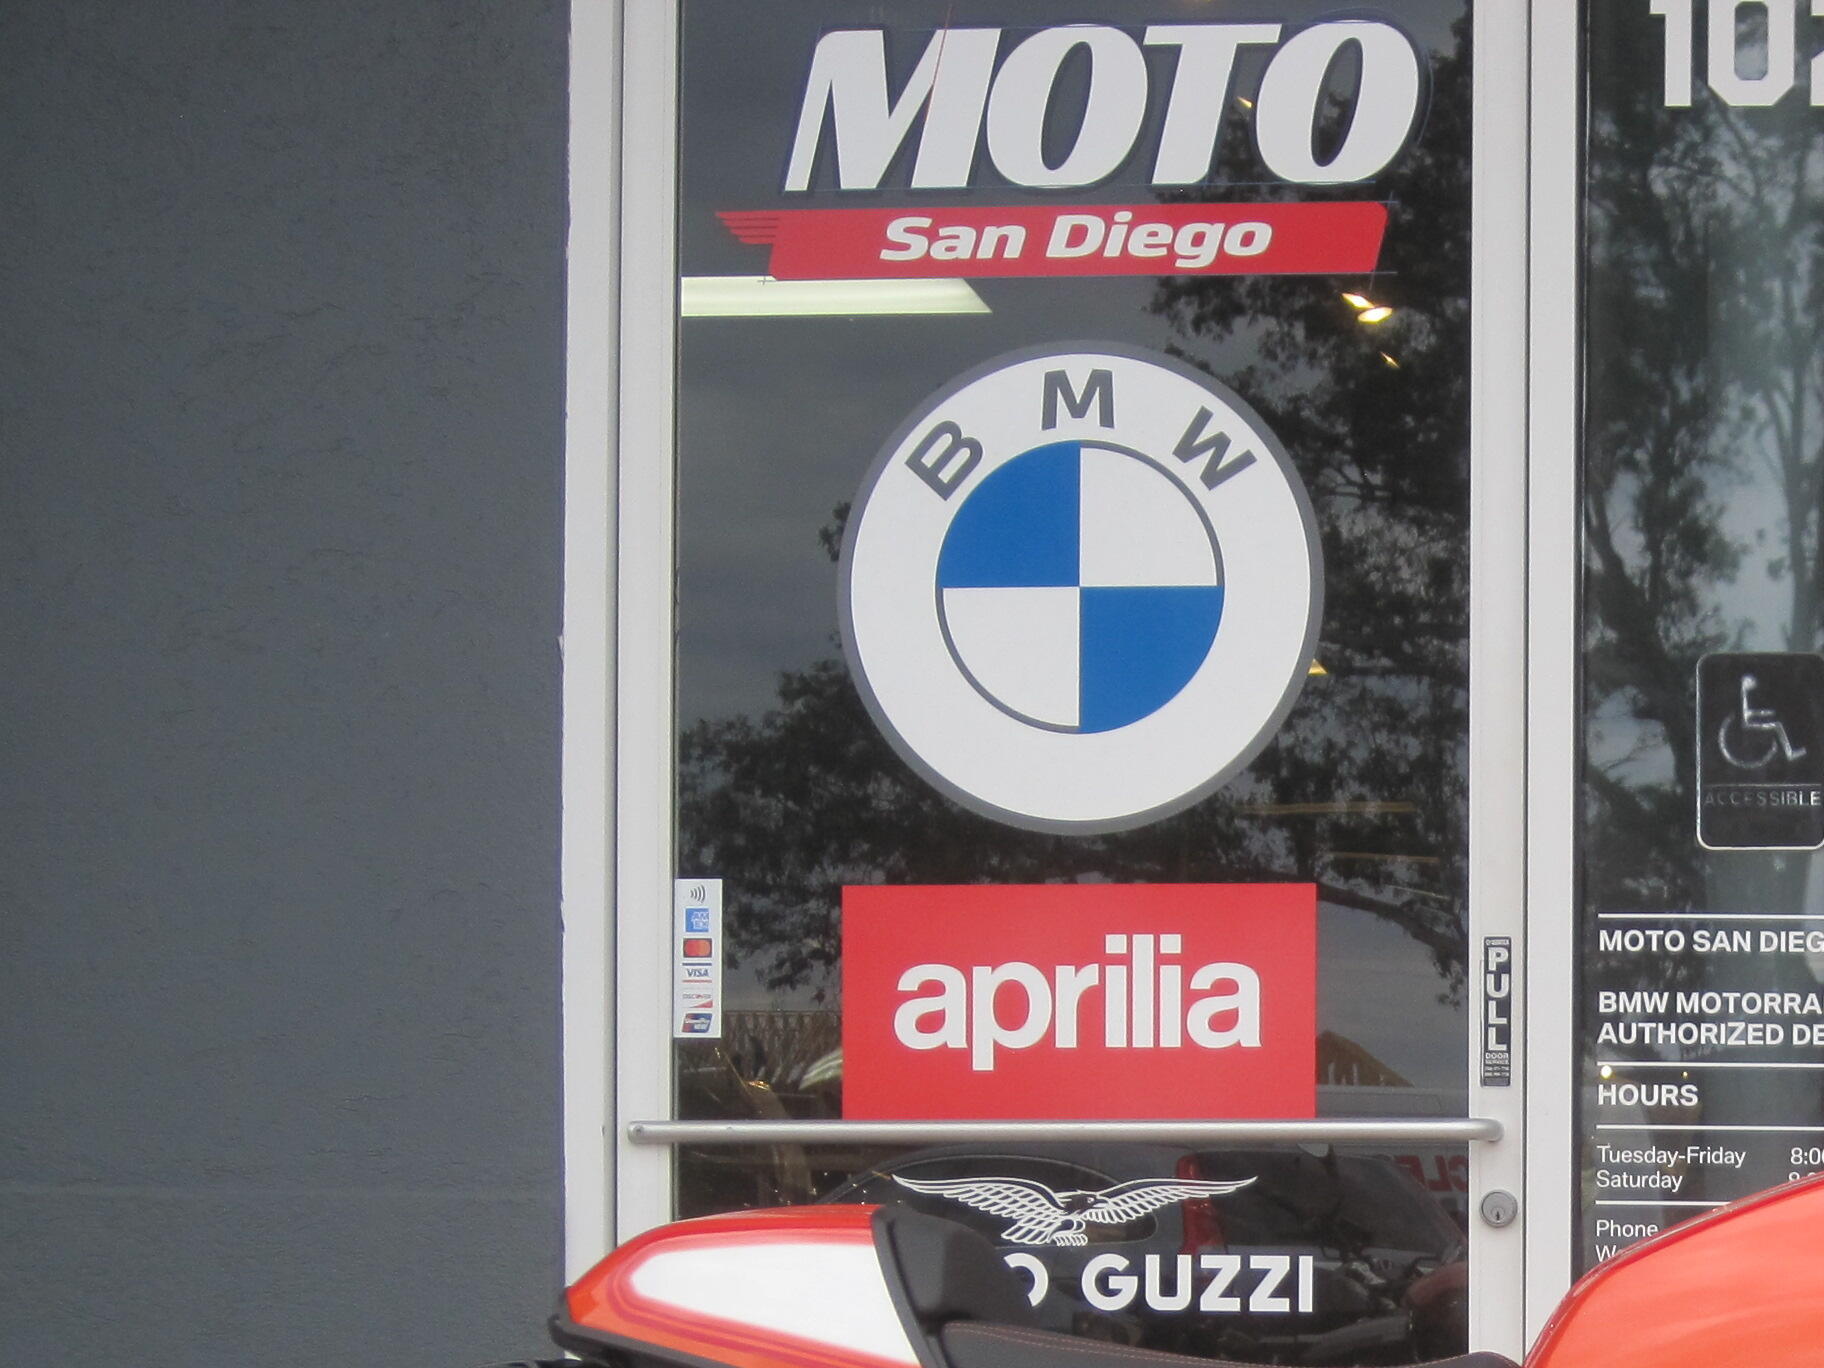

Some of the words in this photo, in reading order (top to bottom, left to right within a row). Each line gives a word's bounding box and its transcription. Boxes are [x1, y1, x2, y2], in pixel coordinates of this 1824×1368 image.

[784, 19, 1420, 191] MOTO
[880, 216, 1025, 261] San
[1046, 211, 1273, 269] Diego
[906, 370, 1258, 501] BMW
[1704, 791, 1821, 806] ACCESSIBLE
[1599, 930, 1686, 952] MOTO
[1693, 930, 1751, 953] SAN
[686, 968, 709, 977] VISA
[893, 934, 1262, 1071] aprilia
[1486, 946, 1510, 1050] PULL
[1599, 992, 1668, 1014] BMW
[1598, 1023, 1784, 1046] AUTHORIZED
[1598, 1084, 1698, 1107] HOURS
[1596, 1146, 1746, 1168] Tuesday-Friday
[1596, 1170, 1683, 1192] Saturday
[1596, 1219, 1659, 1238] Phone
[1081, 1254, 1313, 1313] GUZZI
